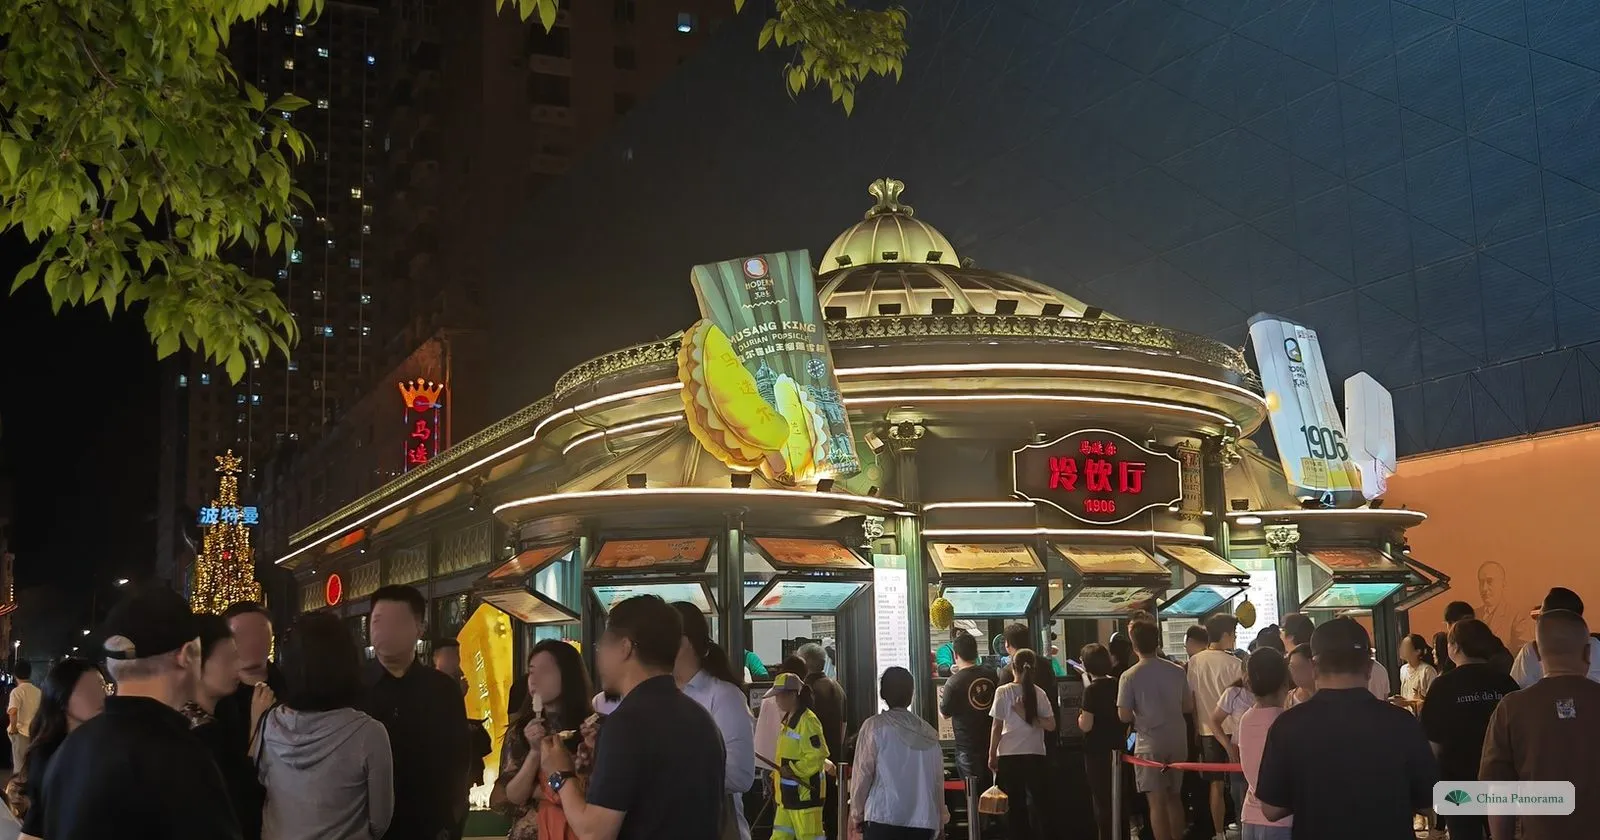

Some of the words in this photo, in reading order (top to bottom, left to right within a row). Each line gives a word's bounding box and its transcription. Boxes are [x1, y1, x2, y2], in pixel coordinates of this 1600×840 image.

[730, 321, 777, 344] MUSANG
[782, 320, 816, 333] KING
[738, 335, 769, 352] DURIAN
[1300, 425, 1348, 462] 1906
[1048, 456, 1146, 493] 冷饮厅
[200, 506, 259, 525] 波特曼
[1083, 499, 1116, 513] 1906
